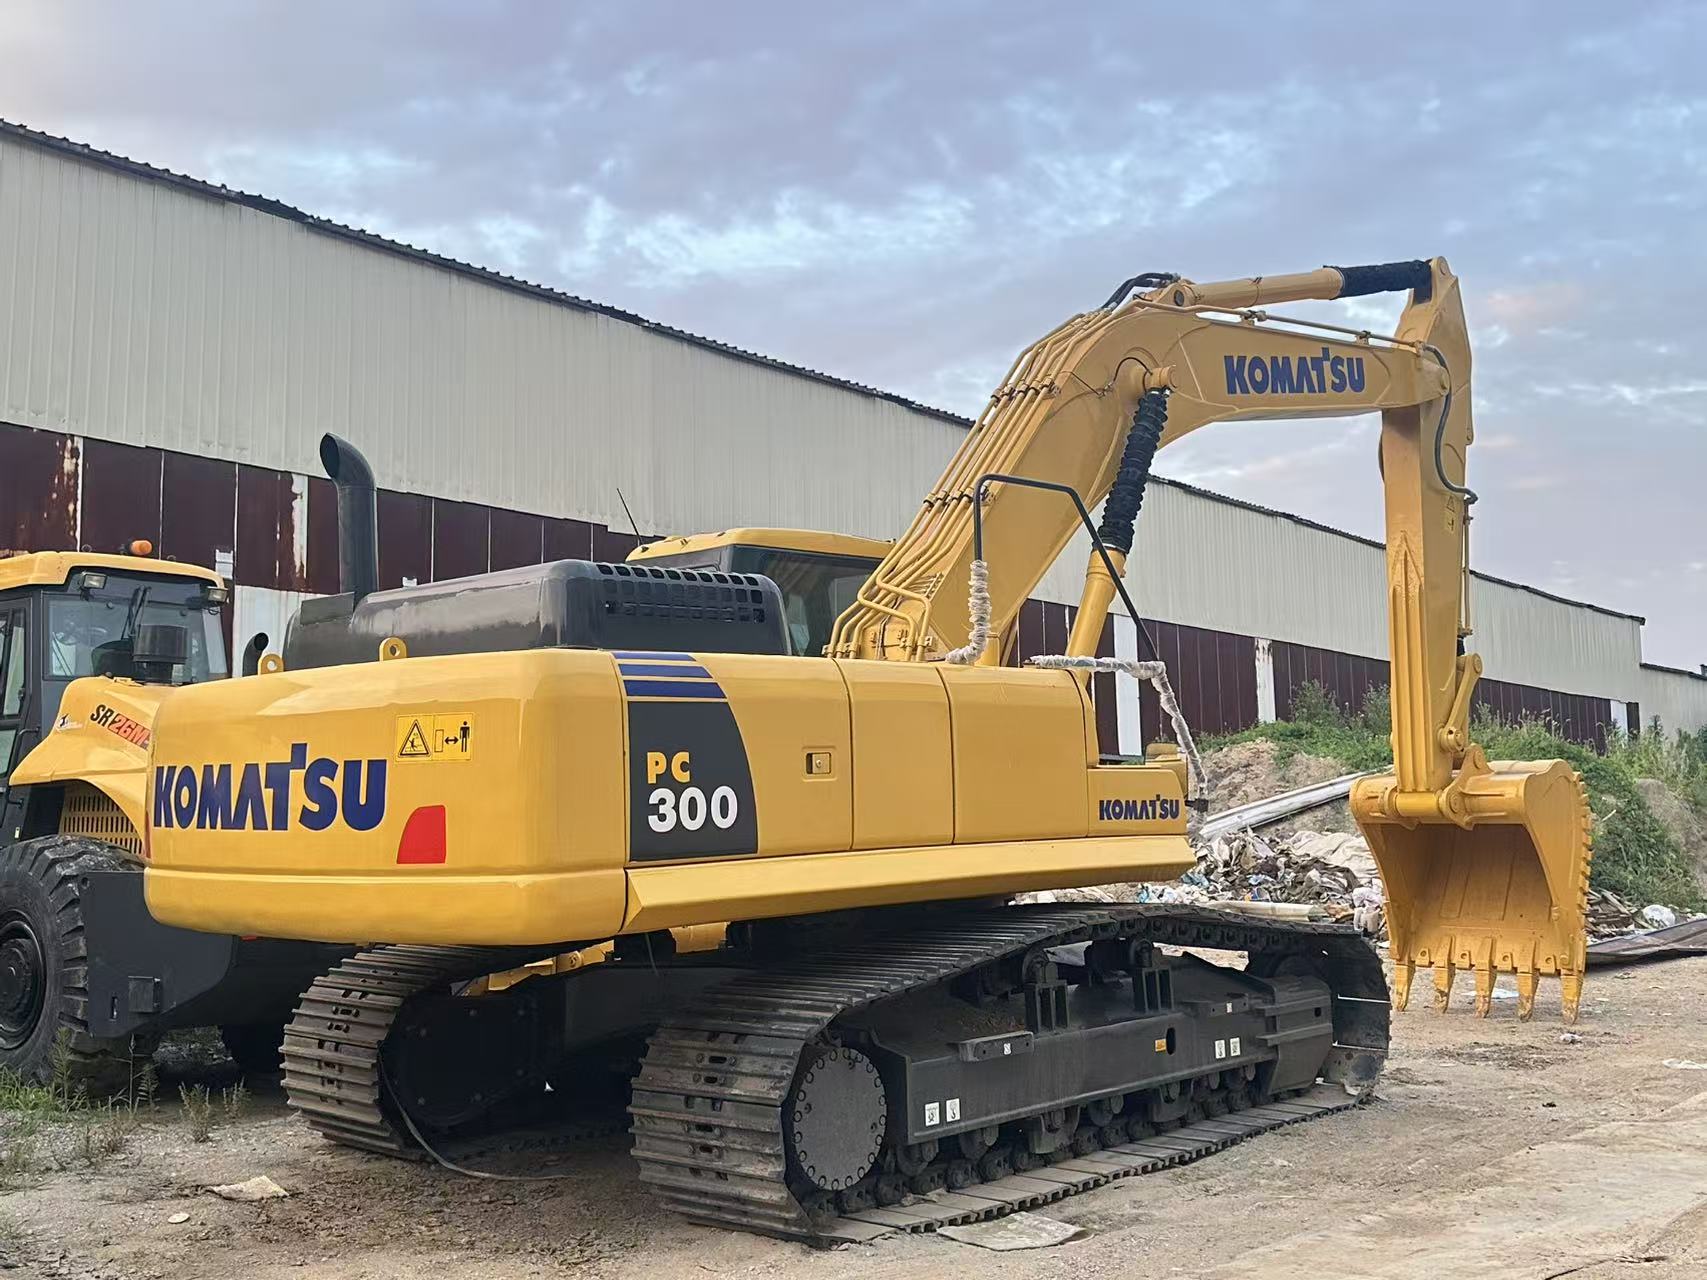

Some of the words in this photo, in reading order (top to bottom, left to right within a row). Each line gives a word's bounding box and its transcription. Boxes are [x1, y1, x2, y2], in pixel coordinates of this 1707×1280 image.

[1224, 347, 1365, 395] KOMATSU
[153, 743, 387, 831] KOMATSU
[647, 751, 690, 784] PC
[648, 785, 738, 833] 300
[1099, 794, 1180, 820] KOMATSU
